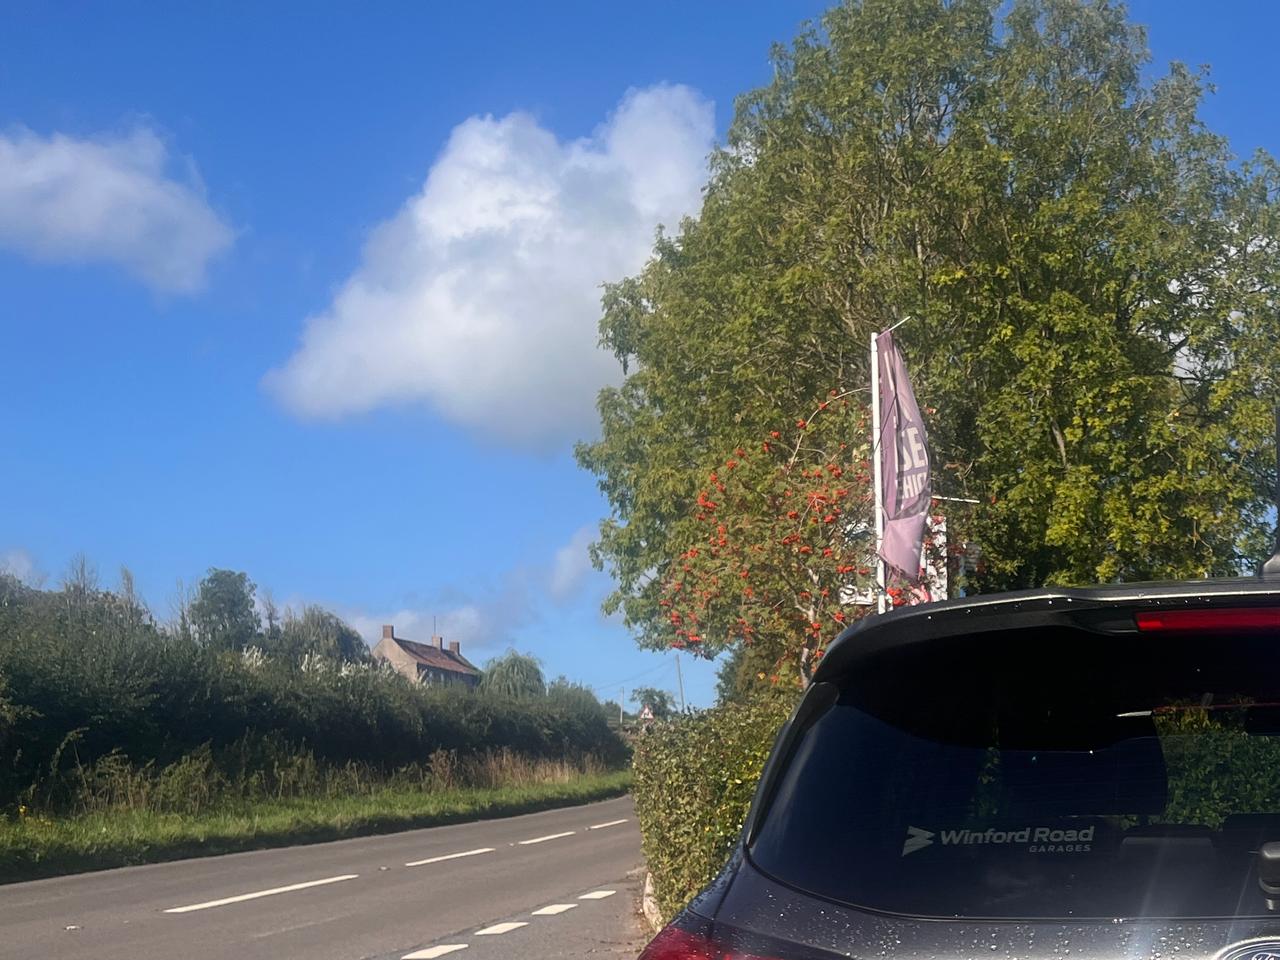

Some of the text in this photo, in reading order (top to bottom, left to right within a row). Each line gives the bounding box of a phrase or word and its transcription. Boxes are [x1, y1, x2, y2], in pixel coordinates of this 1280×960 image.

[940, 826, 1095, 845] Winford Road
[1028, 844, 1092, 853] GARAGES
